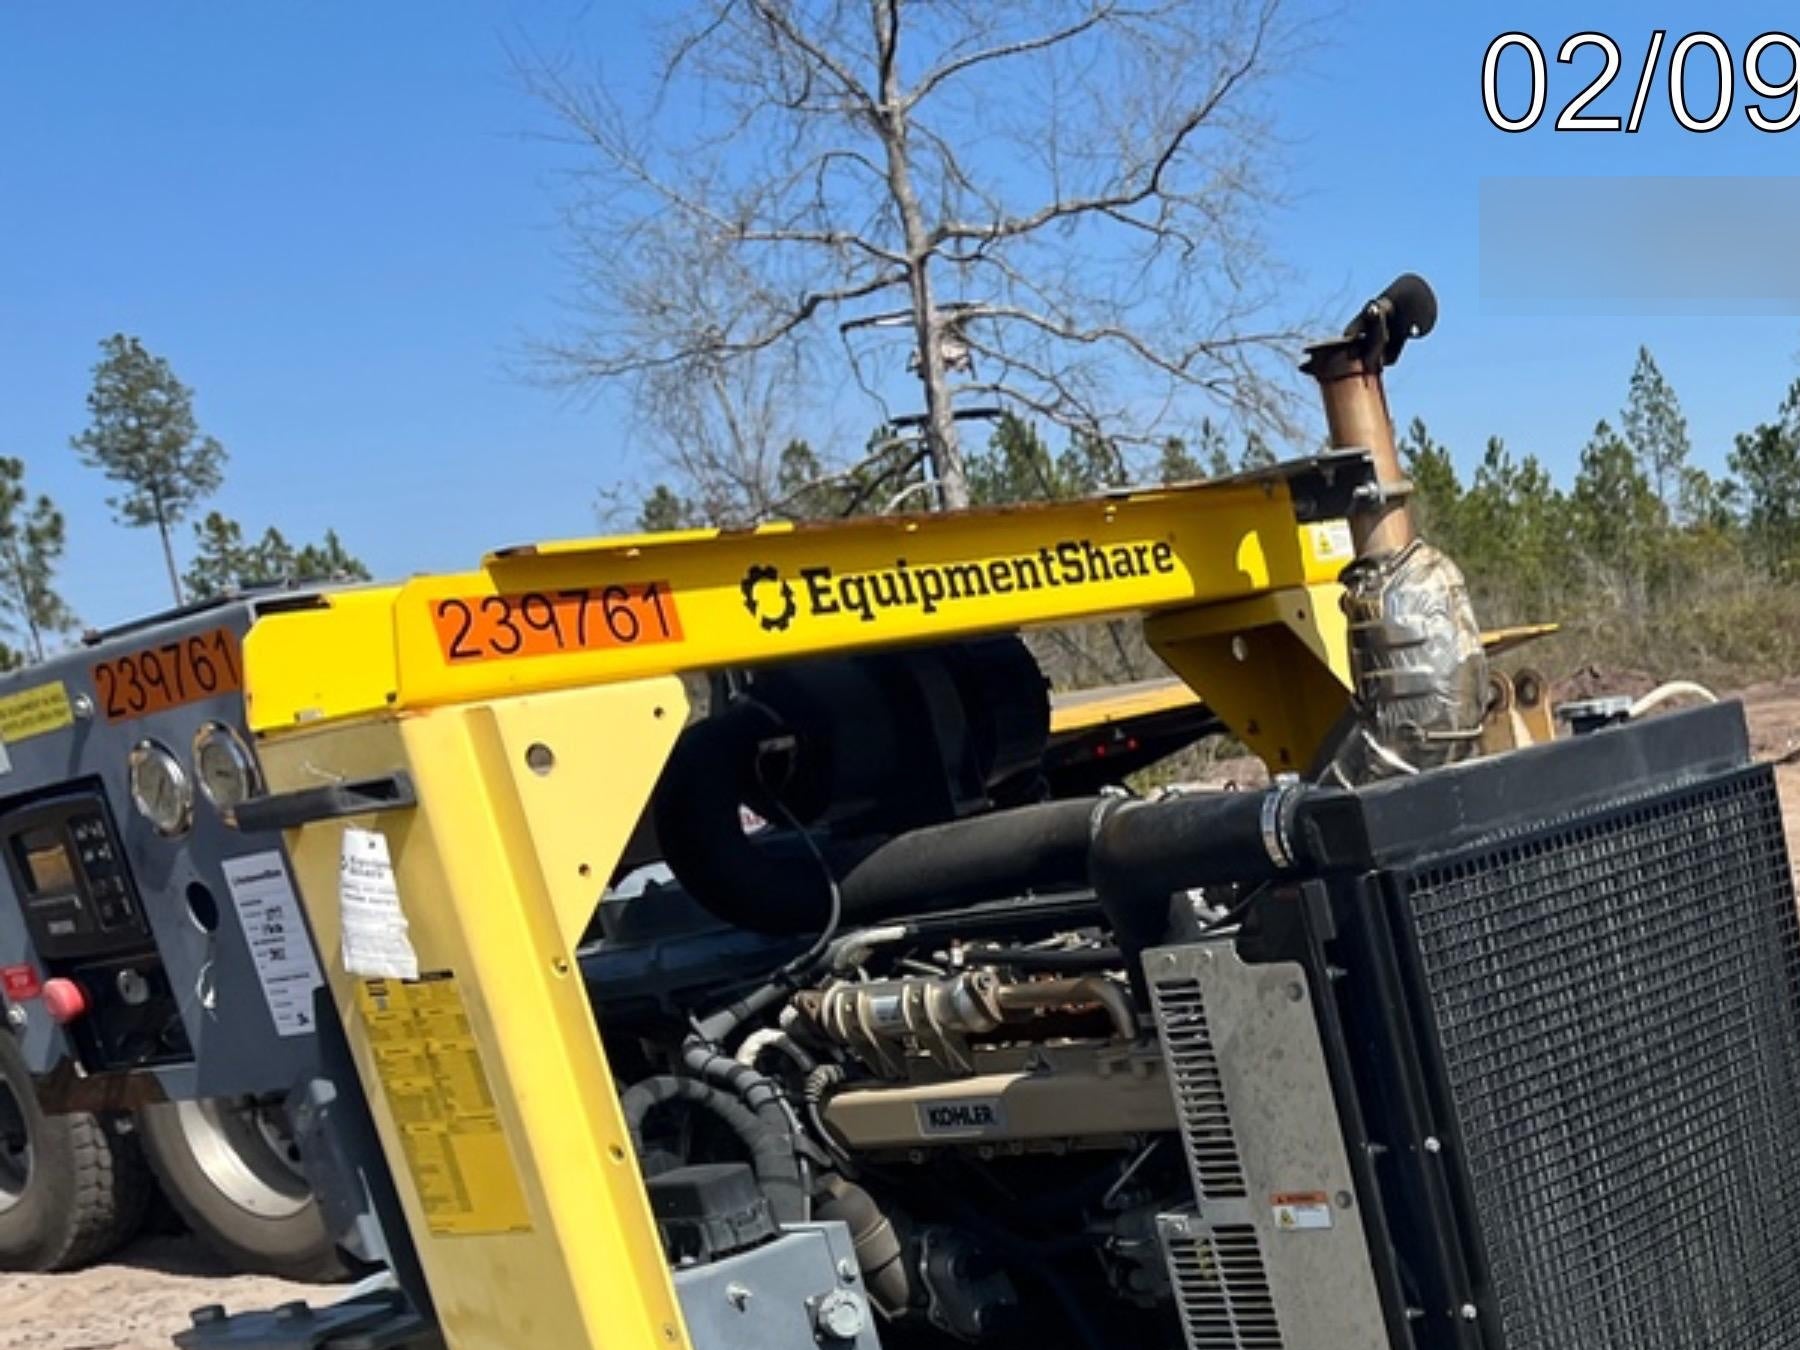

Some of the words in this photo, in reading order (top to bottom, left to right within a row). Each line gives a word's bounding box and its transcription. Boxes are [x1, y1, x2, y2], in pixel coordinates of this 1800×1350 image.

[438, 582, 670, 659] 239761
[800, 539, 1175, 622] EquipmentShare
[95, 629, 238, 718] 239761
[928, 1104, 998, 1129] KOHLER
